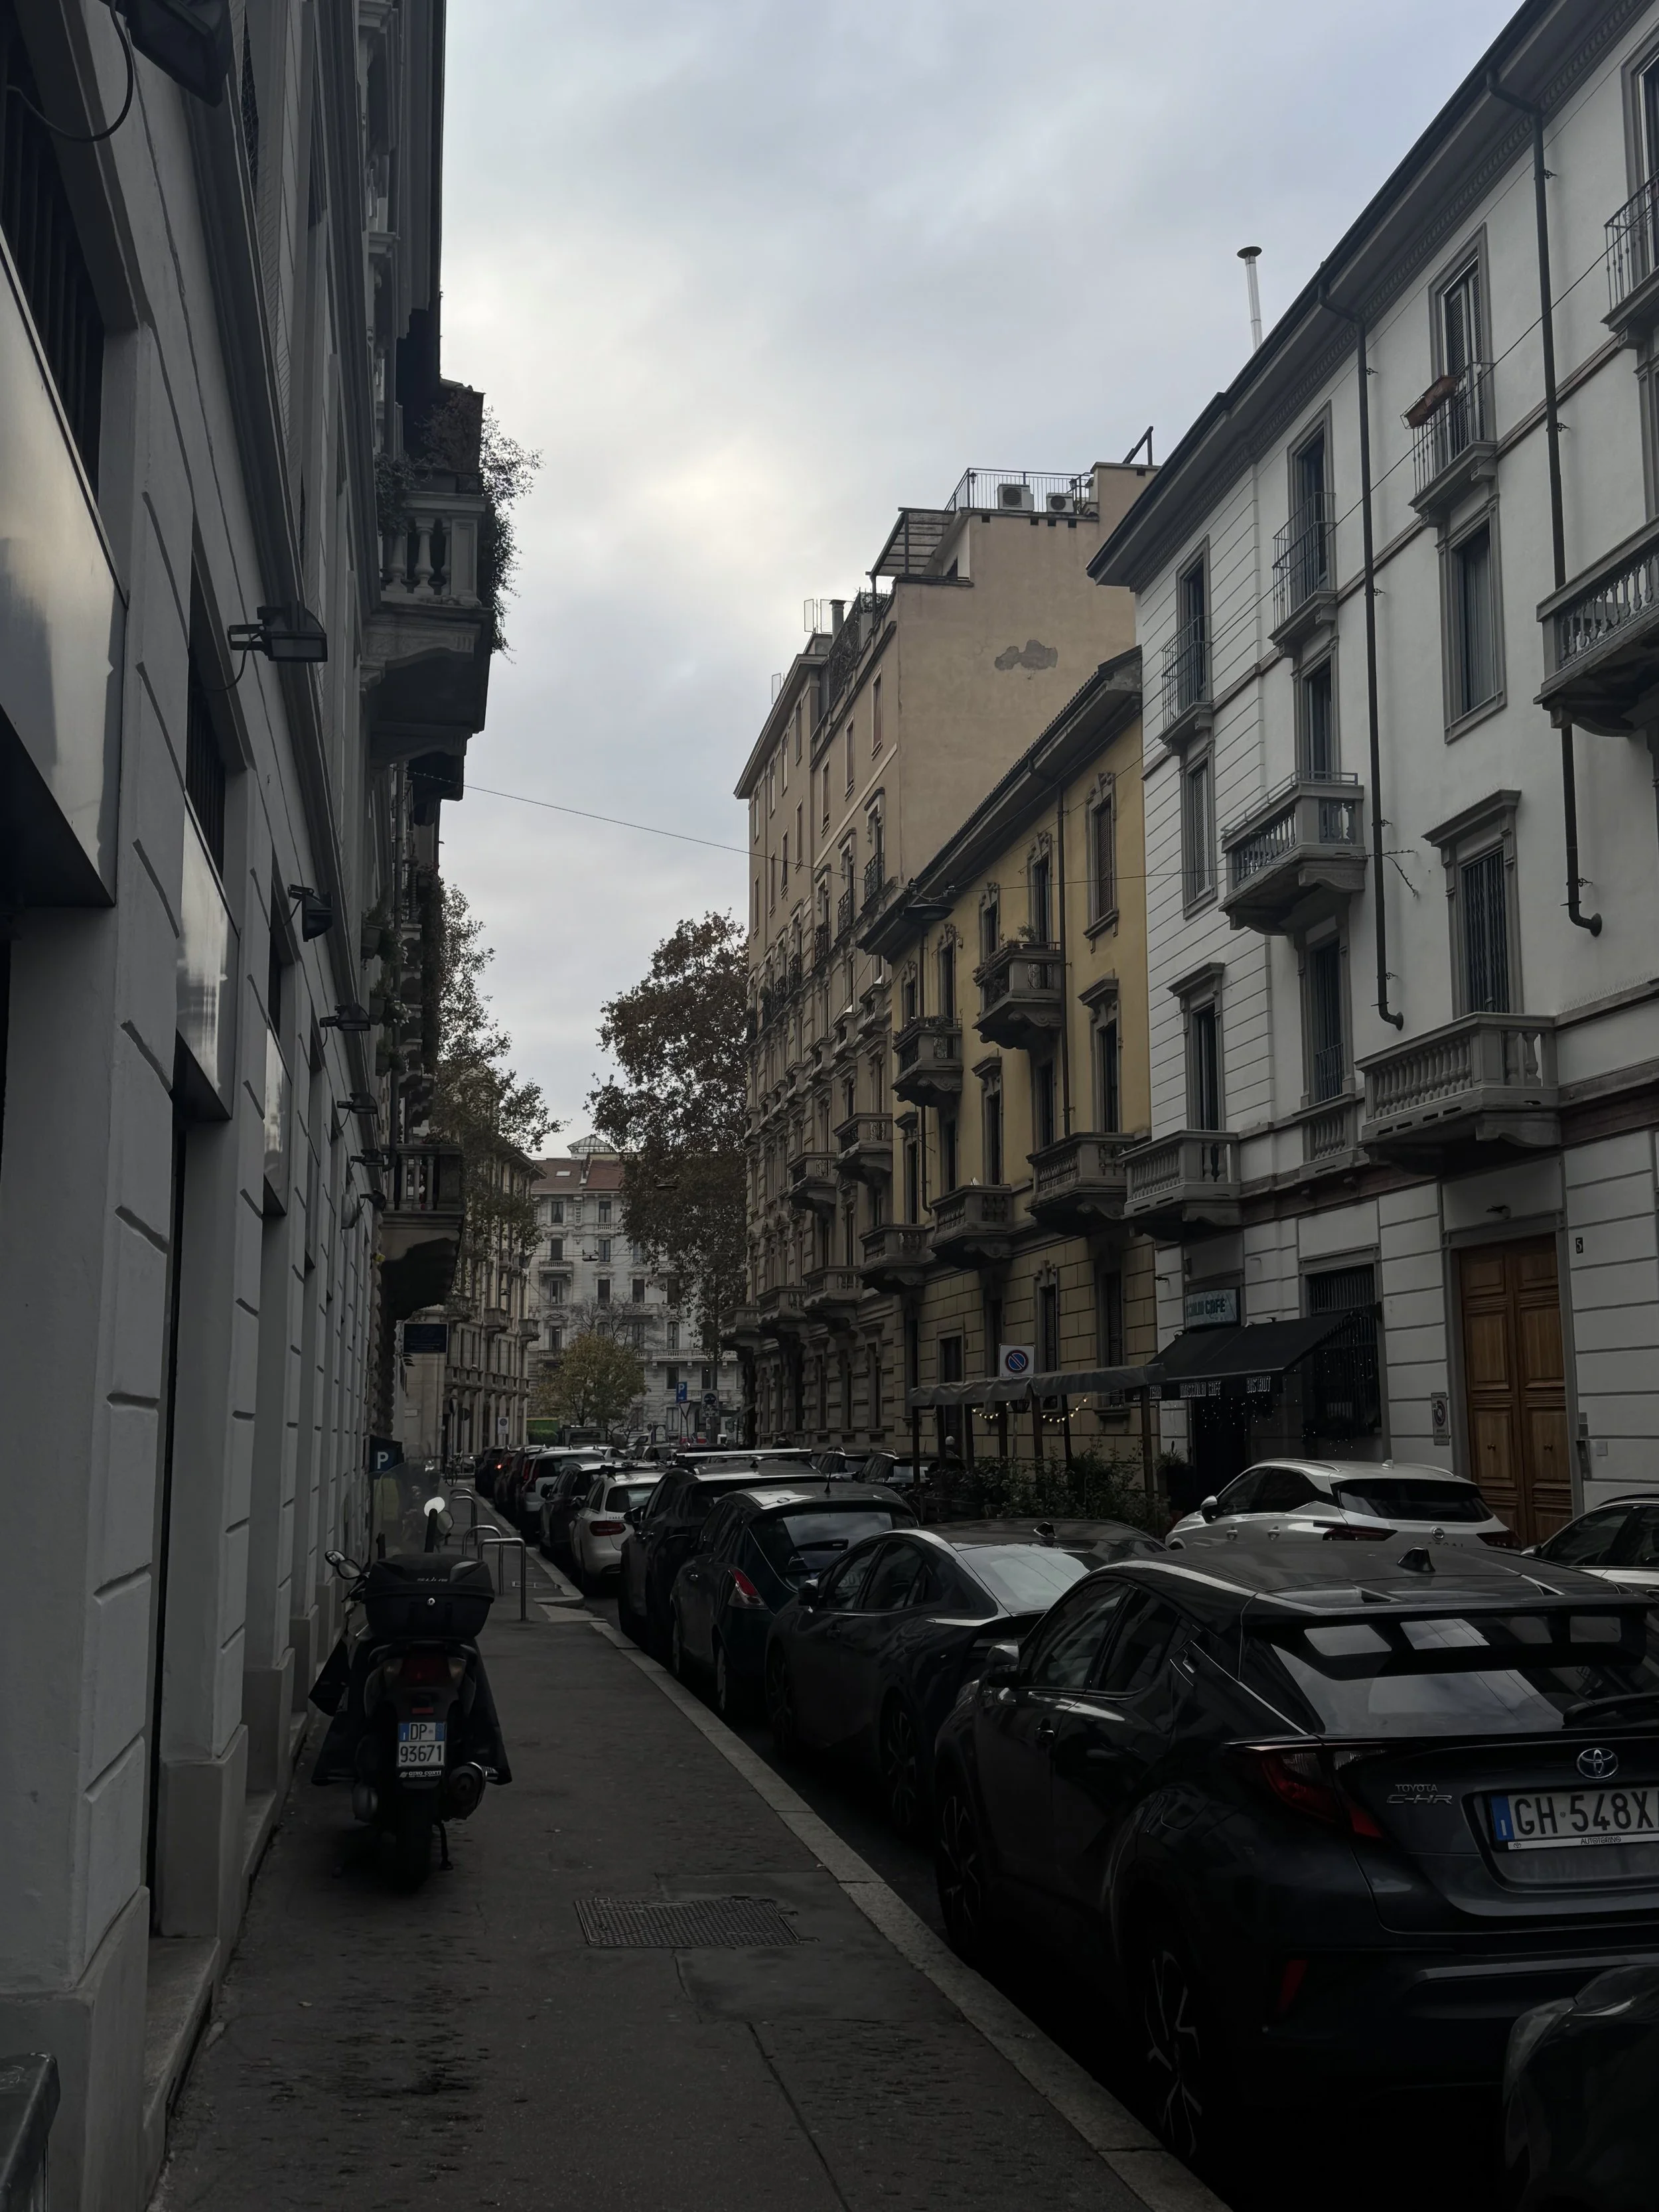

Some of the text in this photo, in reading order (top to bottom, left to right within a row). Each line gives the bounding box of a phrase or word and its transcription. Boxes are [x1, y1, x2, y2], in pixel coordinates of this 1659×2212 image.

[1576, 1239, 1583, 1252] 5
[678, 1383, 685, 1394] P
[377, 1451, 389, 1469] P
[410, 1724, 427, 1740] DP
[400, 1745, 441, 1763] 93671
[1395, 1784, 1438, 1793] TOYOTA
[1386, 1794, 1452, 1805] C-HR
[1514, 1797, 1558, 1835] GH
[1569, 1791, 1659, 1832] 548X
